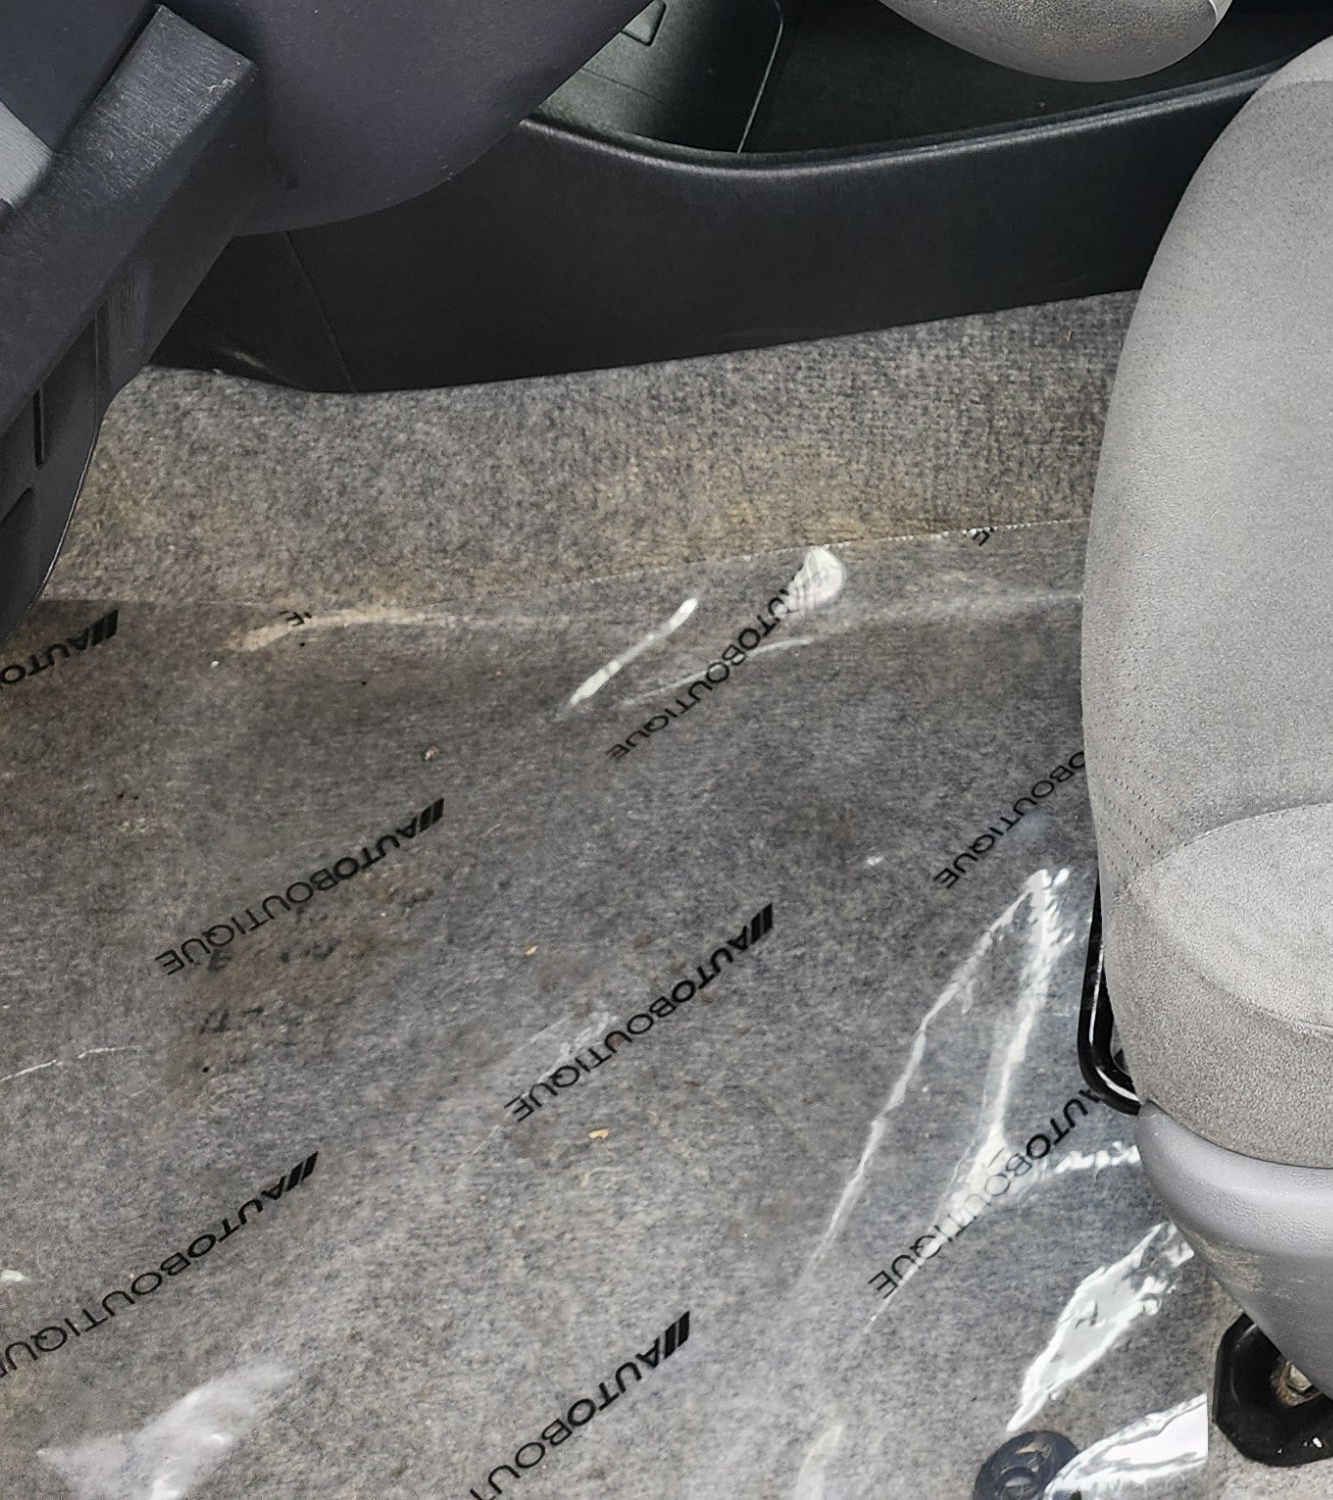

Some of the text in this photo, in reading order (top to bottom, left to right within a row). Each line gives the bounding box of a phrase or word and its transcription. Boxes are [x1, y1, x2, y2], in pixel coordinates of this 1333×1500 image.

[606, 588, 790, 762] UTOBOUTIQUE
[154, 815, 419, 976] AUTOBOUTIQUE
[504, 925, 750, 1113] AUTOBOUTIQUE
[0, 1176, 287, 1378] AUTOBOUTIQU
